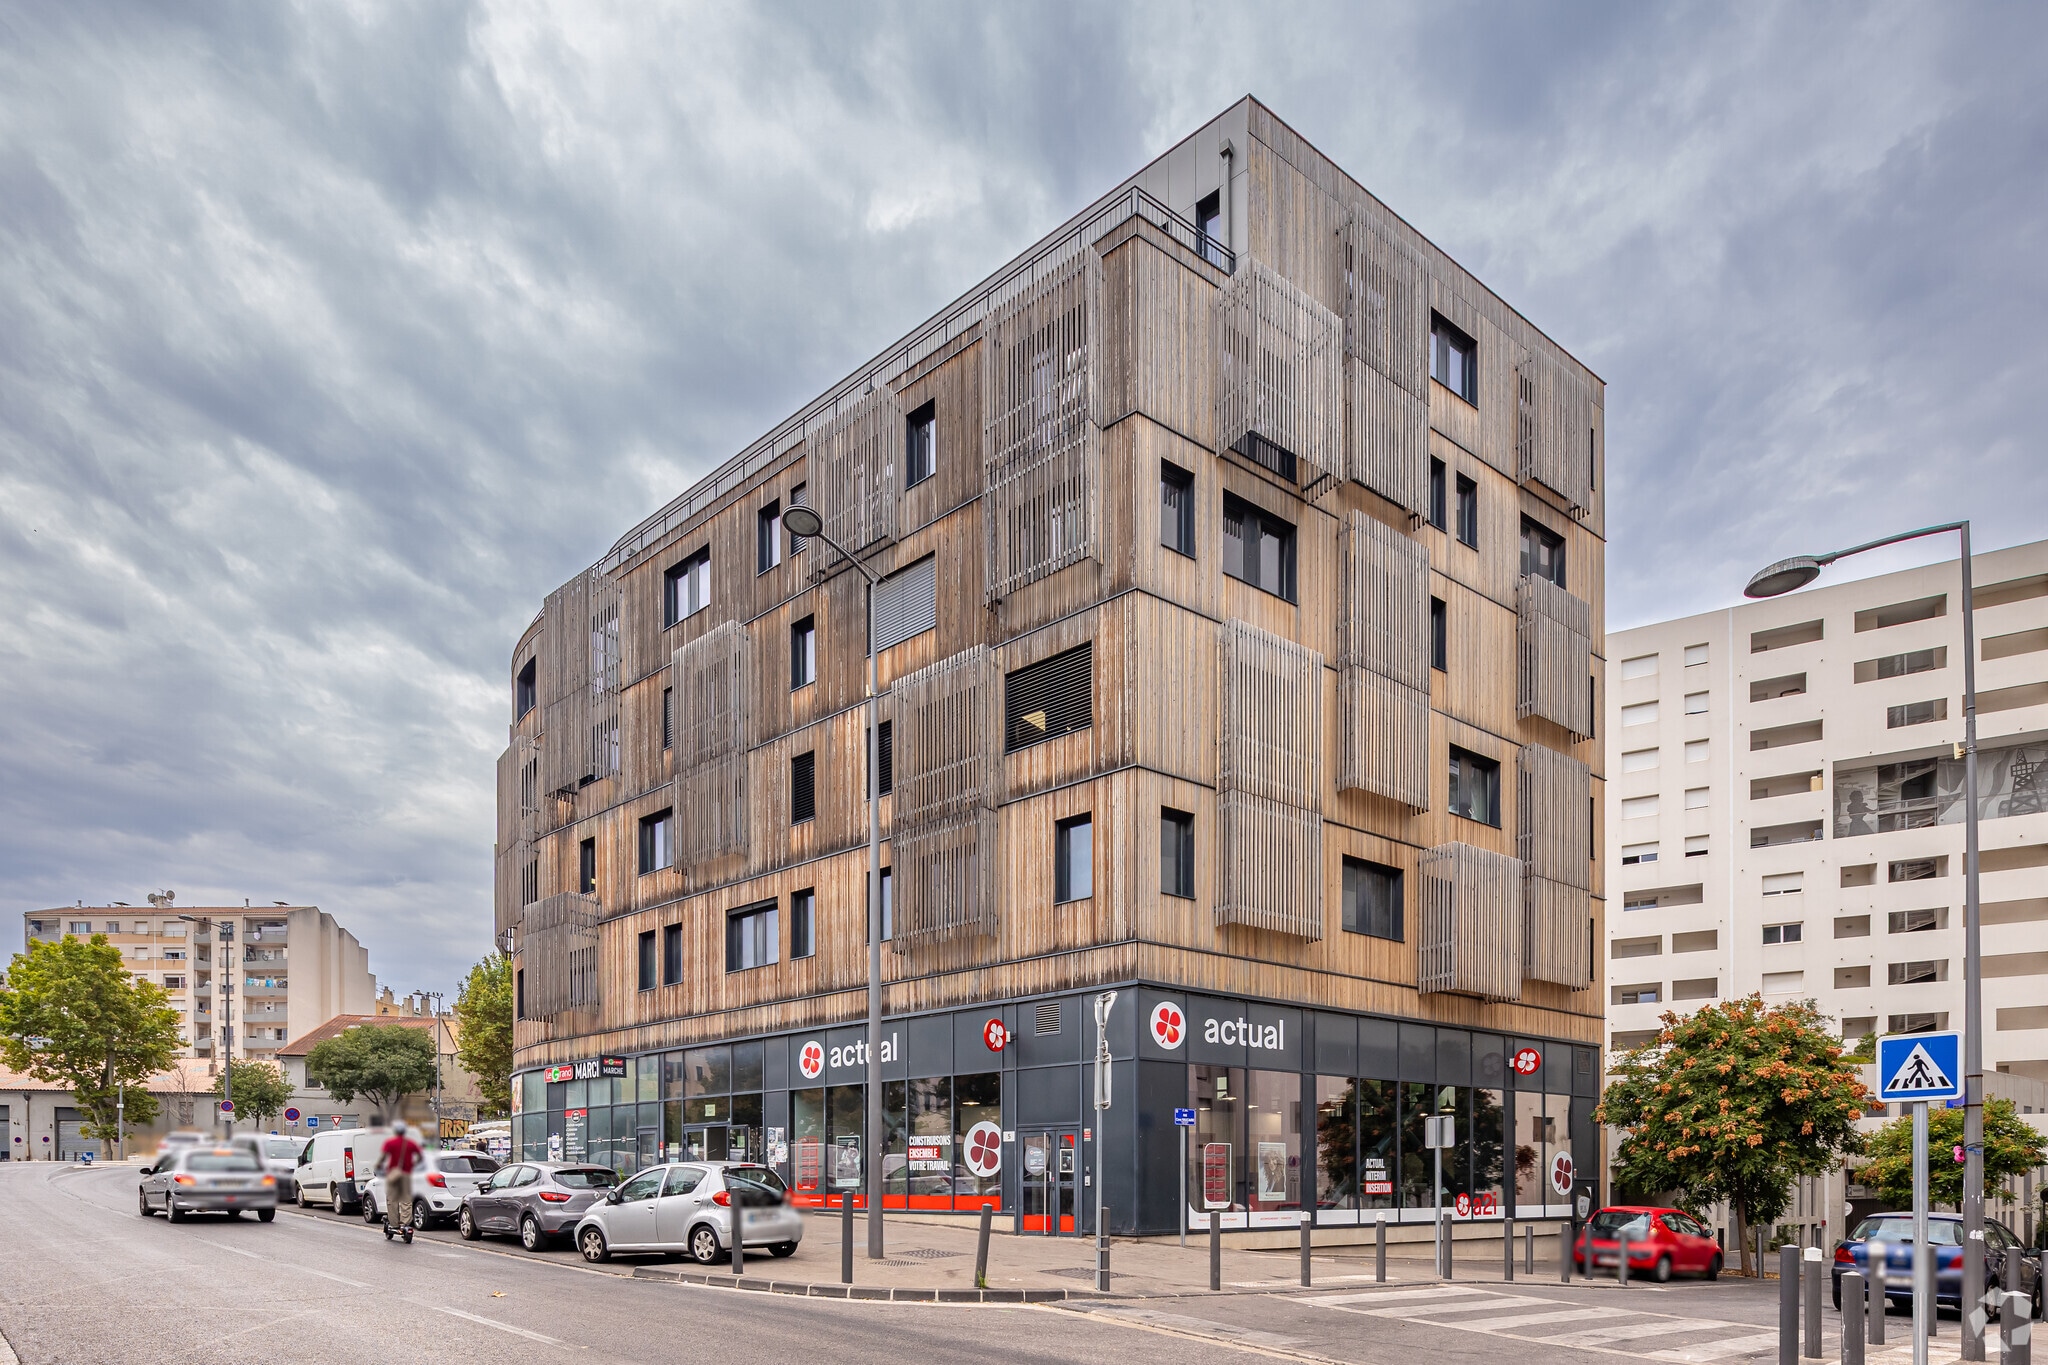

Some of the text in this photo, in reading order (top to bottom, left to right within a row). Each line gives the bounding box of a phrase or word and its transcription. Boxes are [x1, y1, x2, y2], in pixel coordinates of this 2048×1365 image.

[1204, 1016, 1284, 1050] actual
[909, 1135, 951, 1146] CONSTRUISONS
[909, 1148, 938, 1159] ENSEMBLE
[909, 1160, 950, 1171] VOTRE TRAVAIL
[1366, 1158, 1385, 1168] ACTUAL
[1366, 1182, 1392, 1193] INSERTION
[1473, 1191, 1497, 1216] a2i
